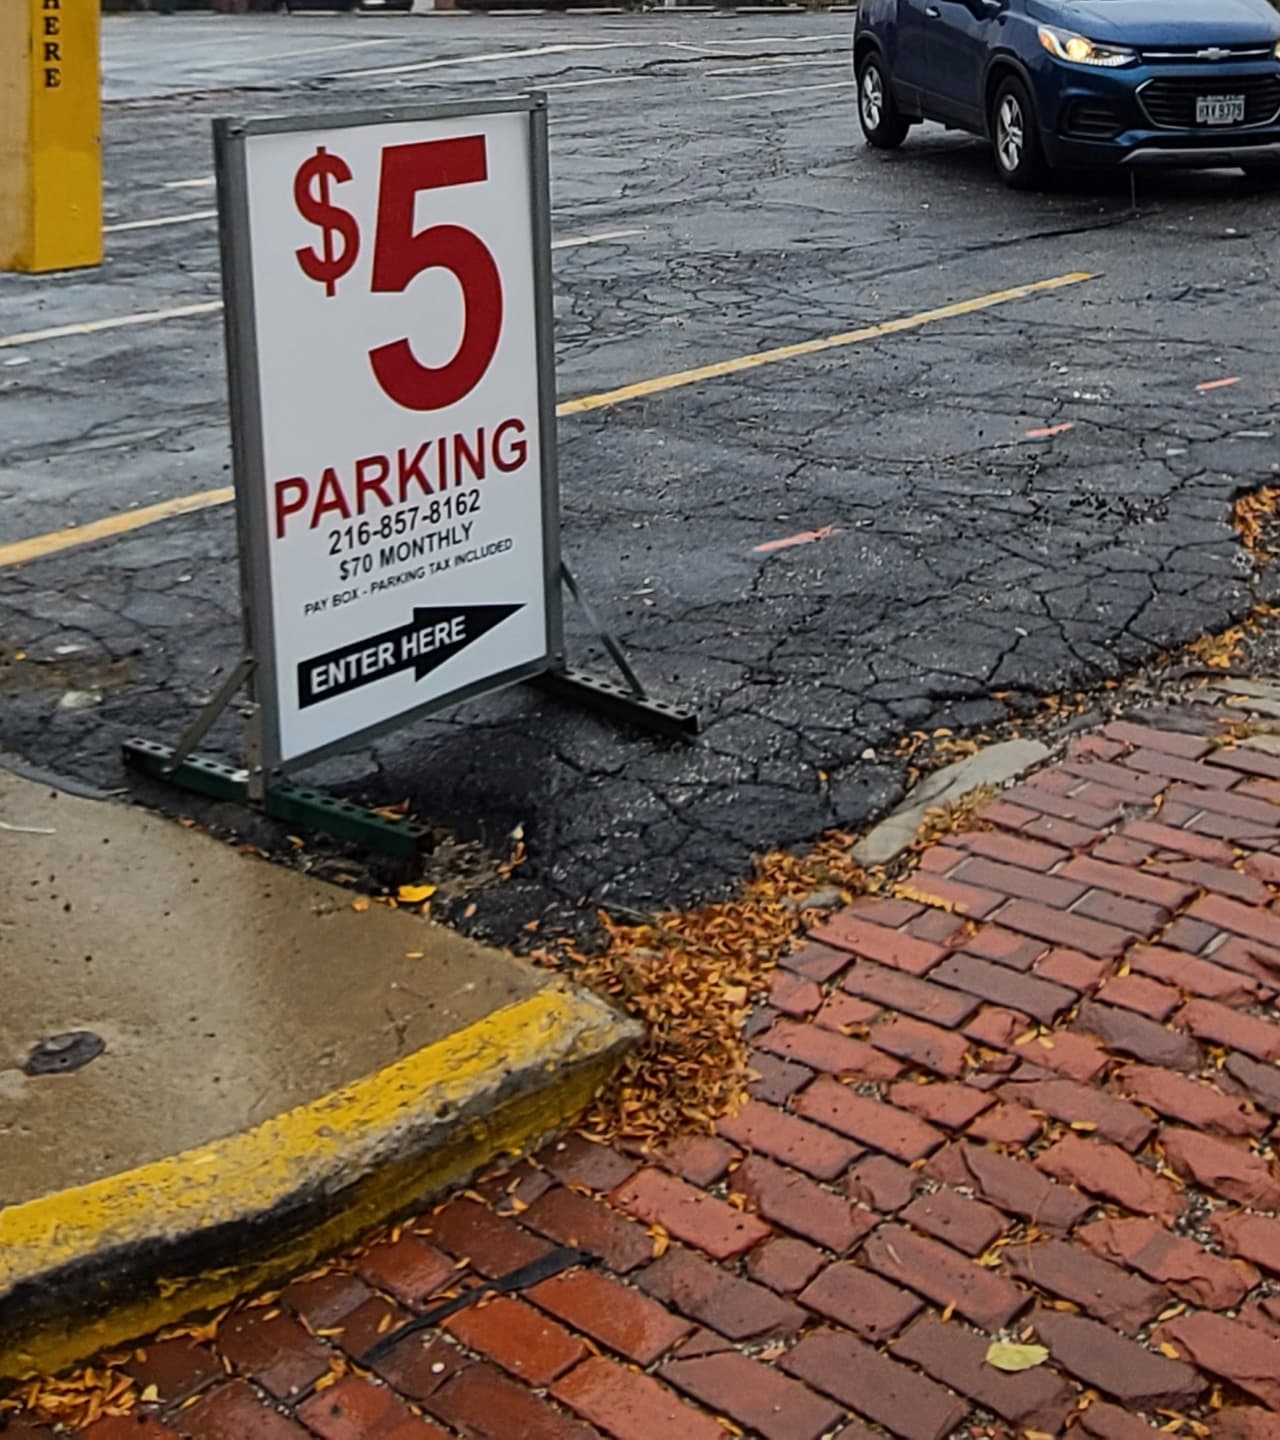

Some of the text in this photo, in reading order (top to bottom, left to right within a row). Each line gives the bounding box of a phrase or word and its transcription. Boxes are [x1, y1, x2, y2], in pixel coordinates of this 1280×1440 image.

[294, 134, 504, 411] $5
[274, 418, 529, 539] PARKING
[328, 489, 482, 556] 216-857-8162
[339, 521, 473, 581] $70 MONTHLY
[304, 598, 328, 616] PAY
[332, 590, 359, 608] BOX
[370, 567, 426, 595] PARKING
[429, 557, 451, 576] TAX
[454, 537, 513, 567] INCLUDED
[311, 615, 467, 695] ENTER HERE
